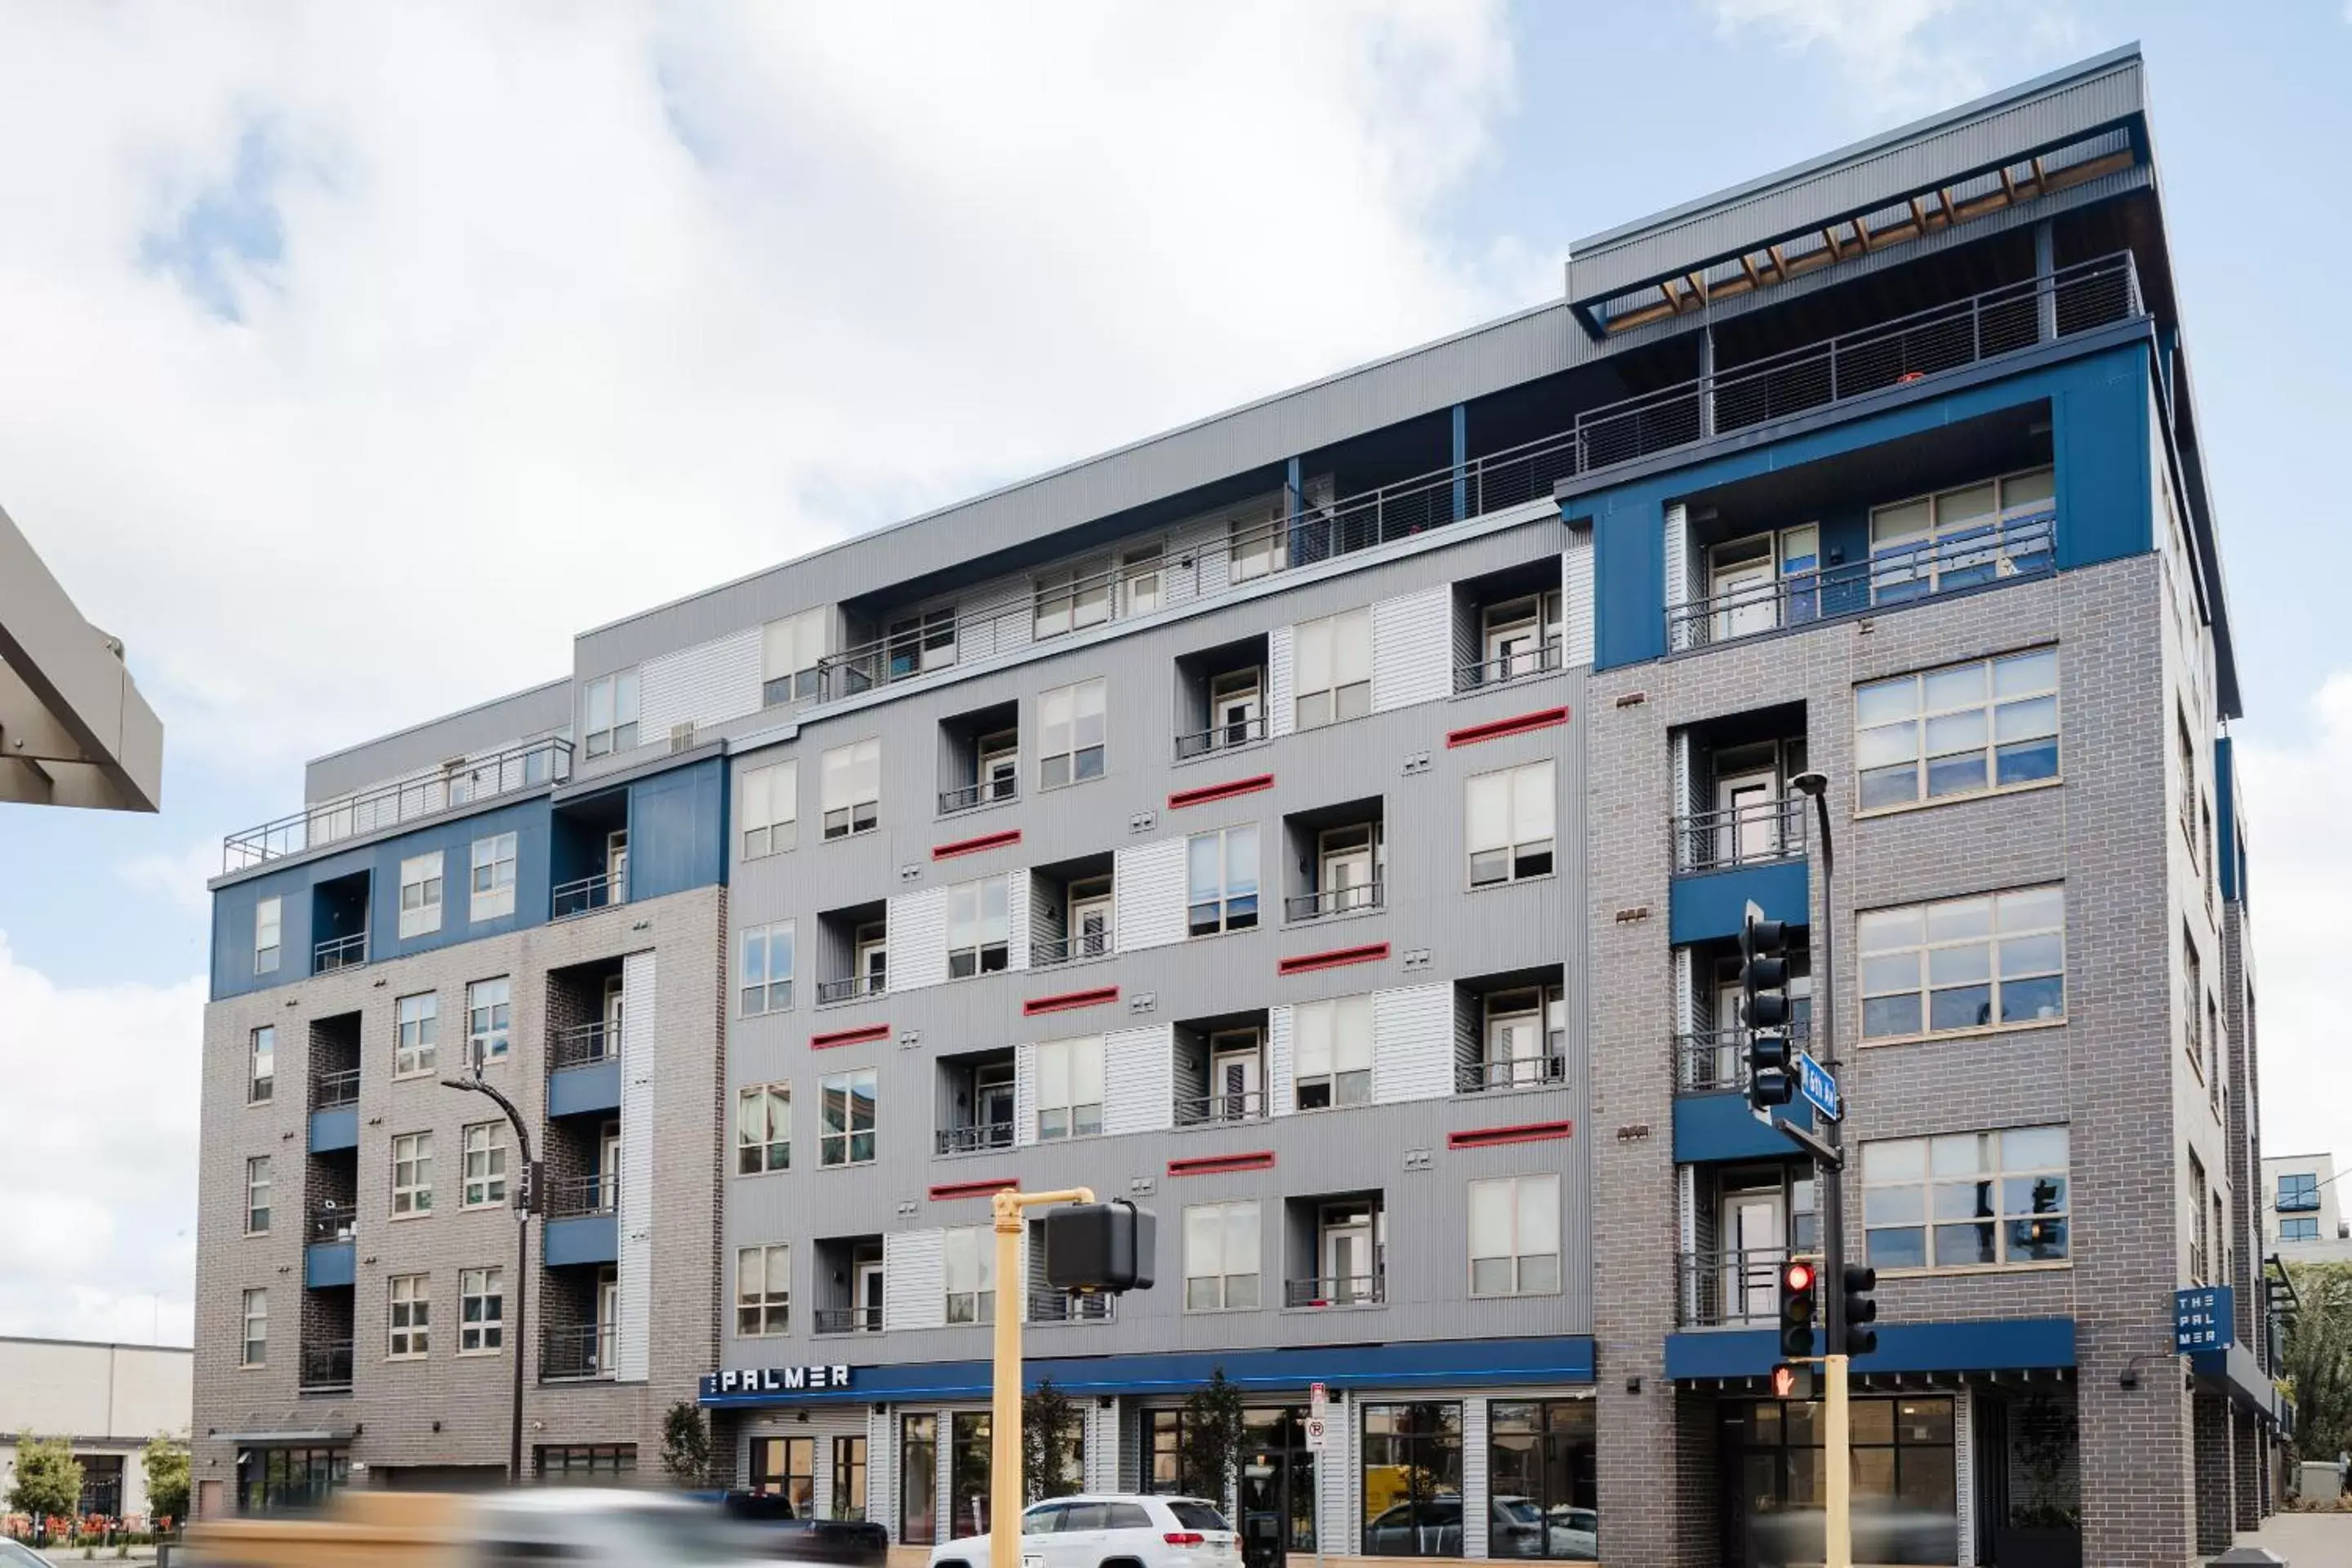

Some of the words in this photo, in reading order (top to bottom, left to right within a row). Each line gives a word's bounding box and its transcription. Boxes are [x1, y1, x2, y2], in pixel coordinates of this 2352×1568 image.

[2178, 1294, 2214, 1309] THE
[2180, 1313, 2215, 1327] PAL
[2179, 1330, 2215, 1344] MER
[722, 1365, 849, 1392] PALMER
